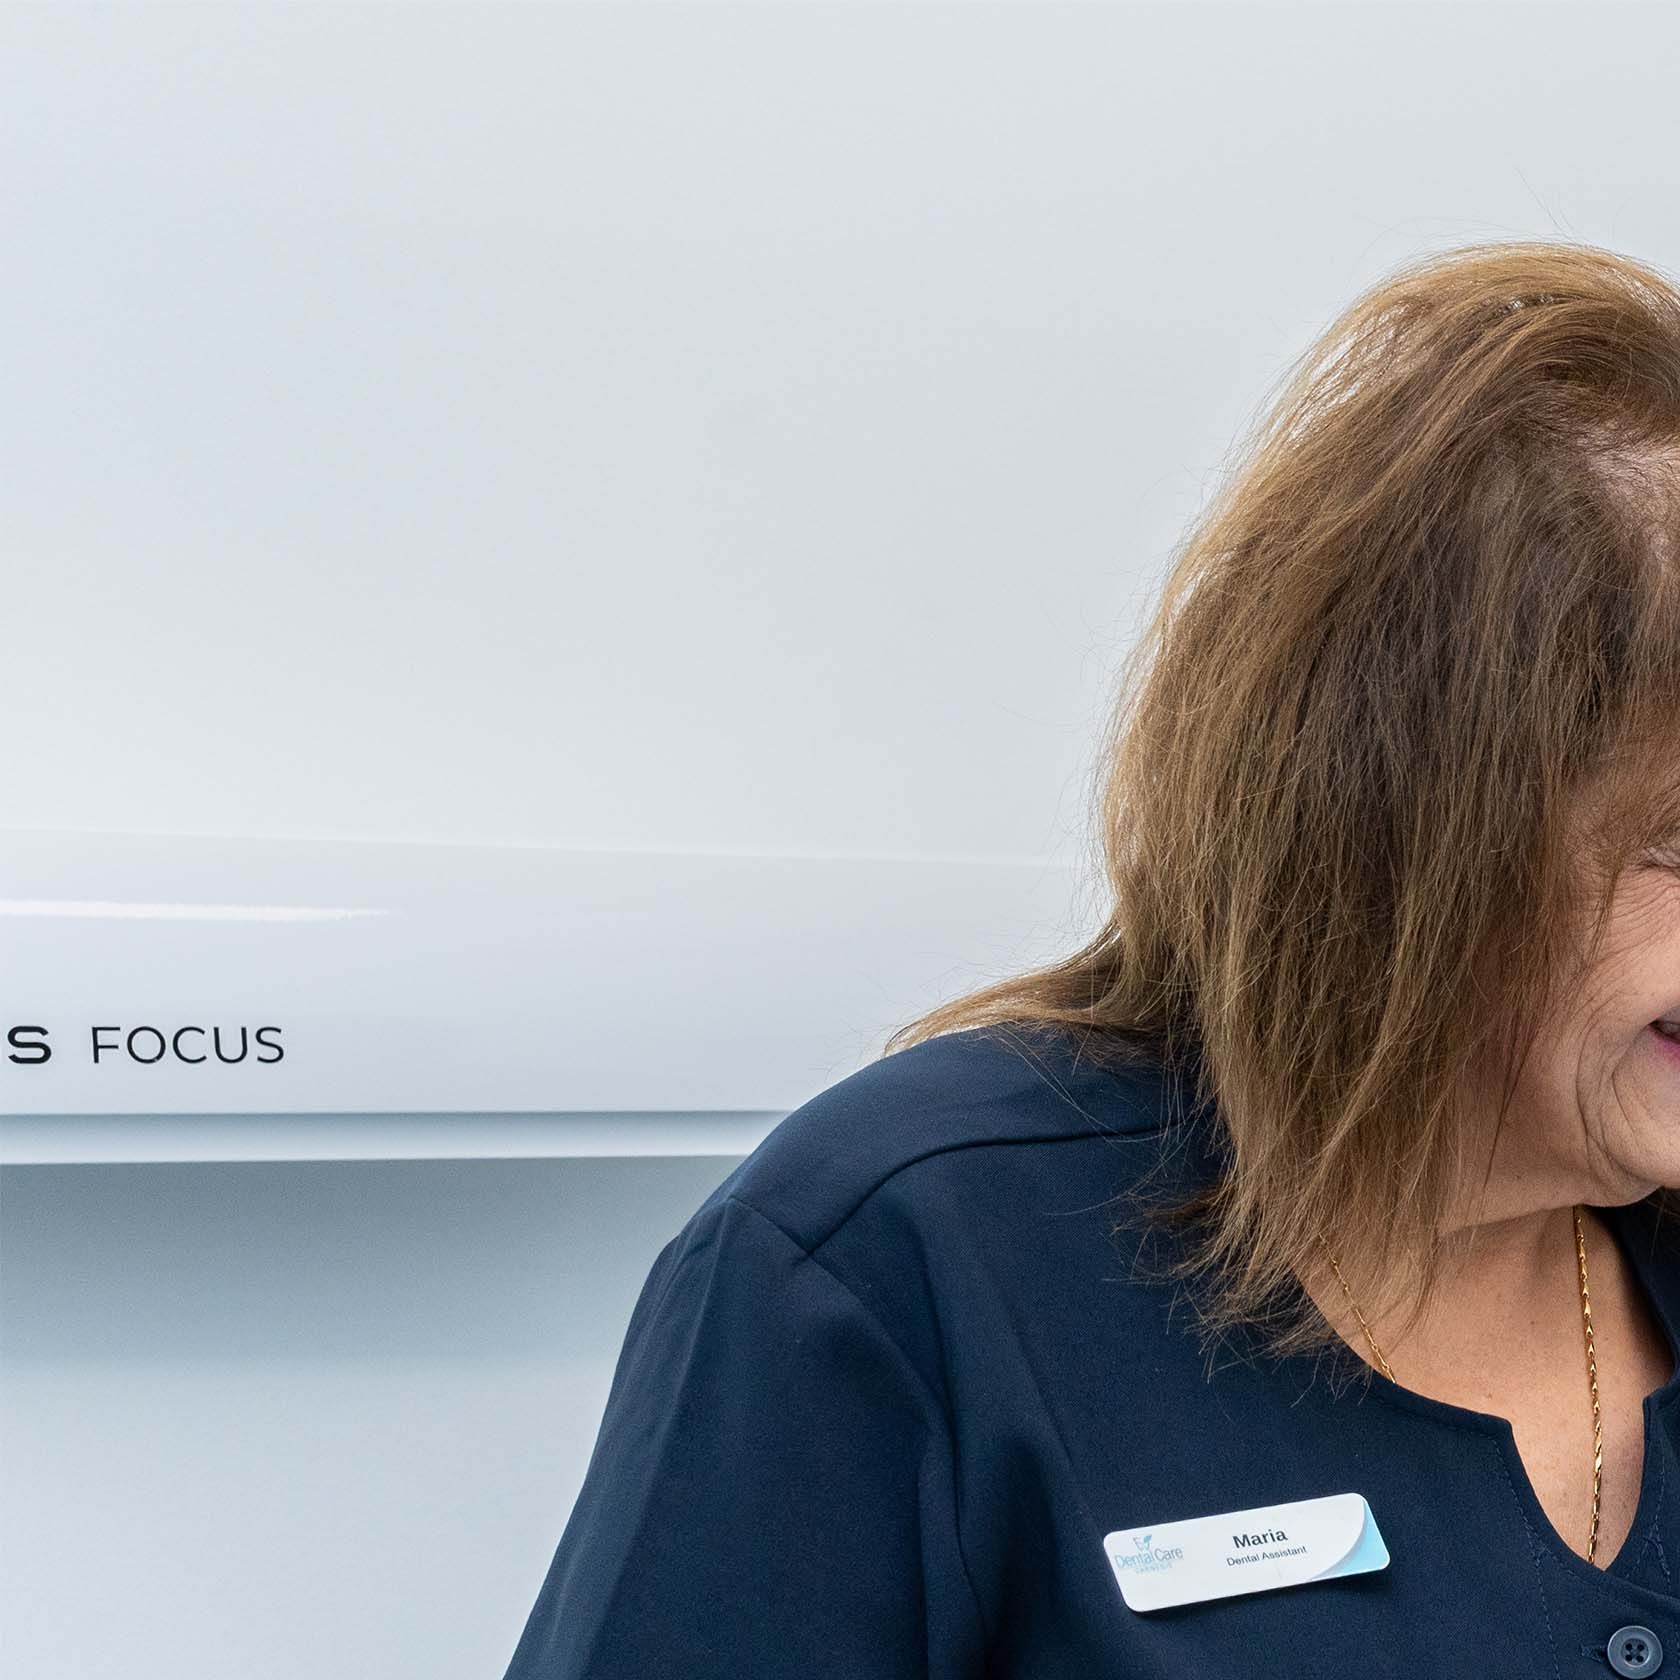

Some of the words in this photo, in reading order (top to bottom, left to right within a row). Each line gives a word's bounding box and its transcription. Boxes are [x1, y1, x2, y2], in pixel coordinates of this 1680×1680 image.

[91, 1026, 285, 1064] FOCUS
[1232, 1528, 1289, 1550] Maria
[1226, 1552, 1260, 1567] Dental
[1262, 1545, 1307, 1561] Assistant
